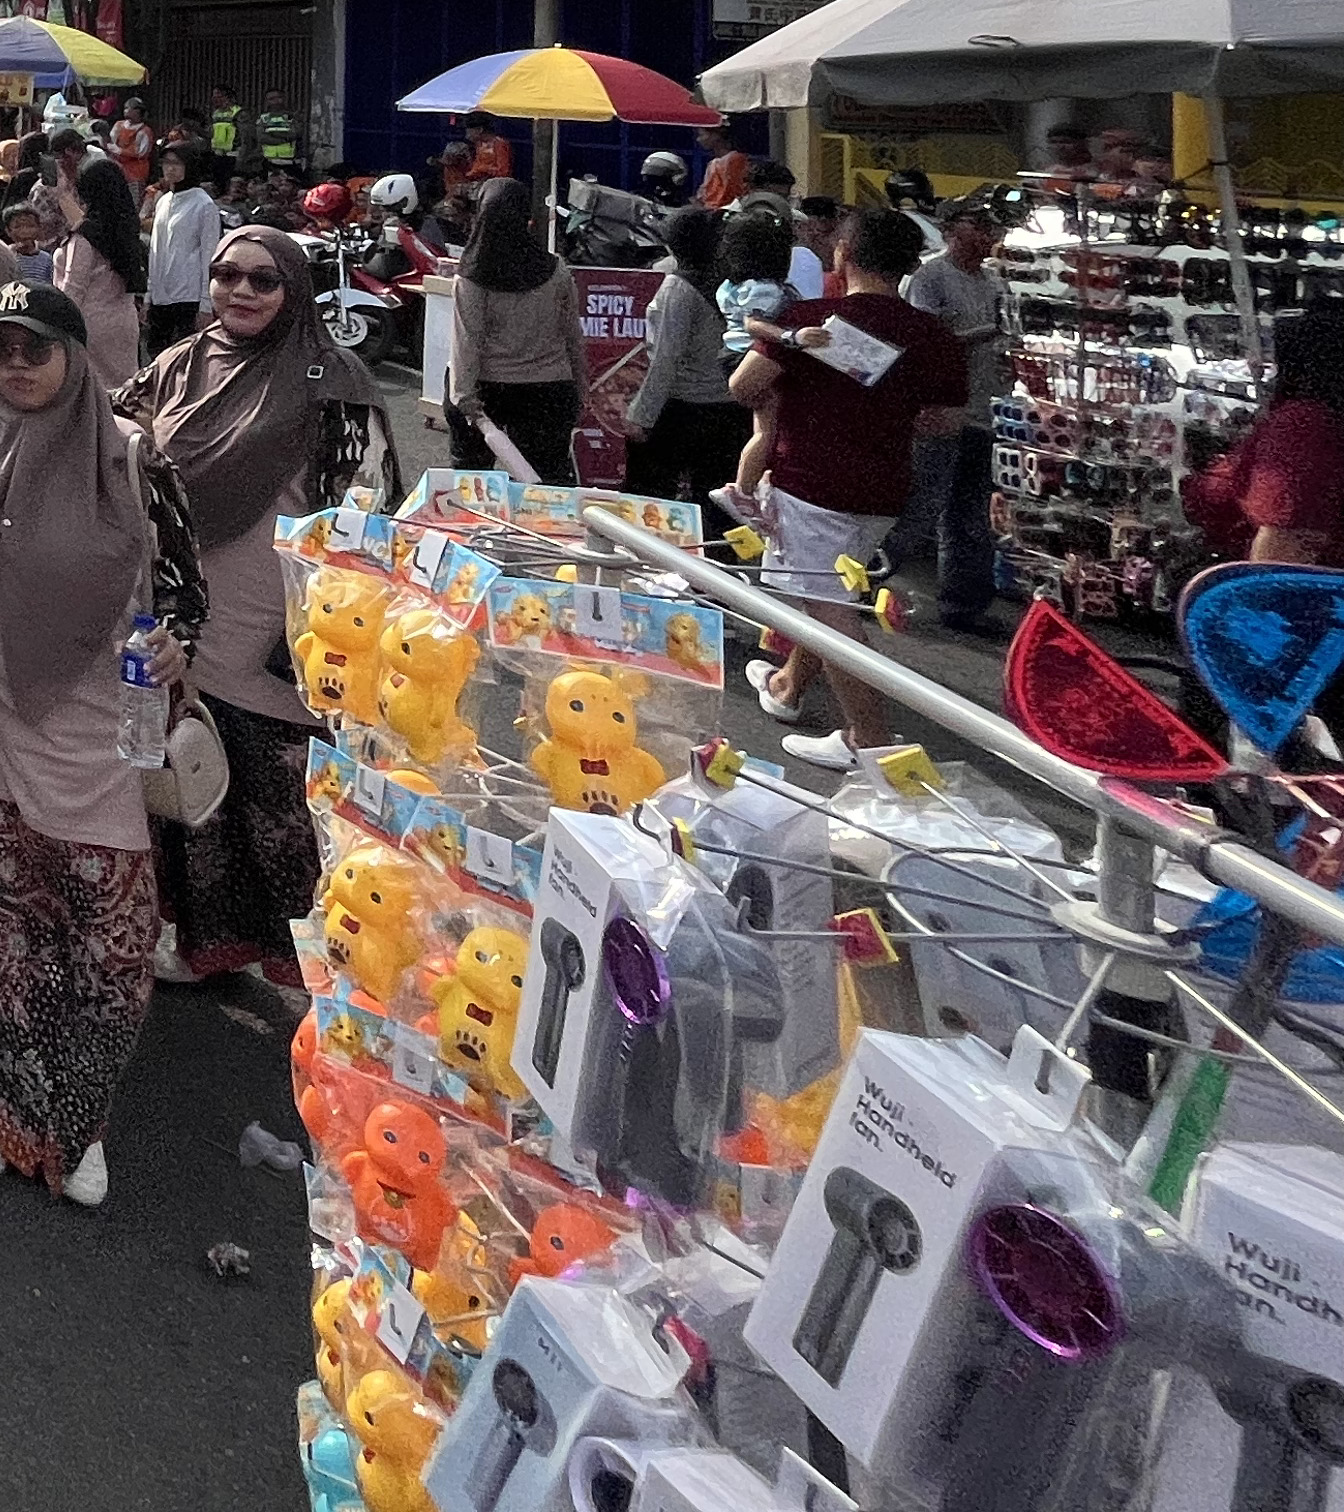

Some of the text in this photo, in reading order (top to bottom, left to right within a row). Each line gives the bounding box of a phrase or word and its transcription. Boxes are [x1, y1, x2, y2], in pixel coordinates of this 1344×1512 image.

[586, 294, 635, 316] SPICY
[613, 318, 649, 339] LAU
[856, 1094, 957, 1189] Handheld
